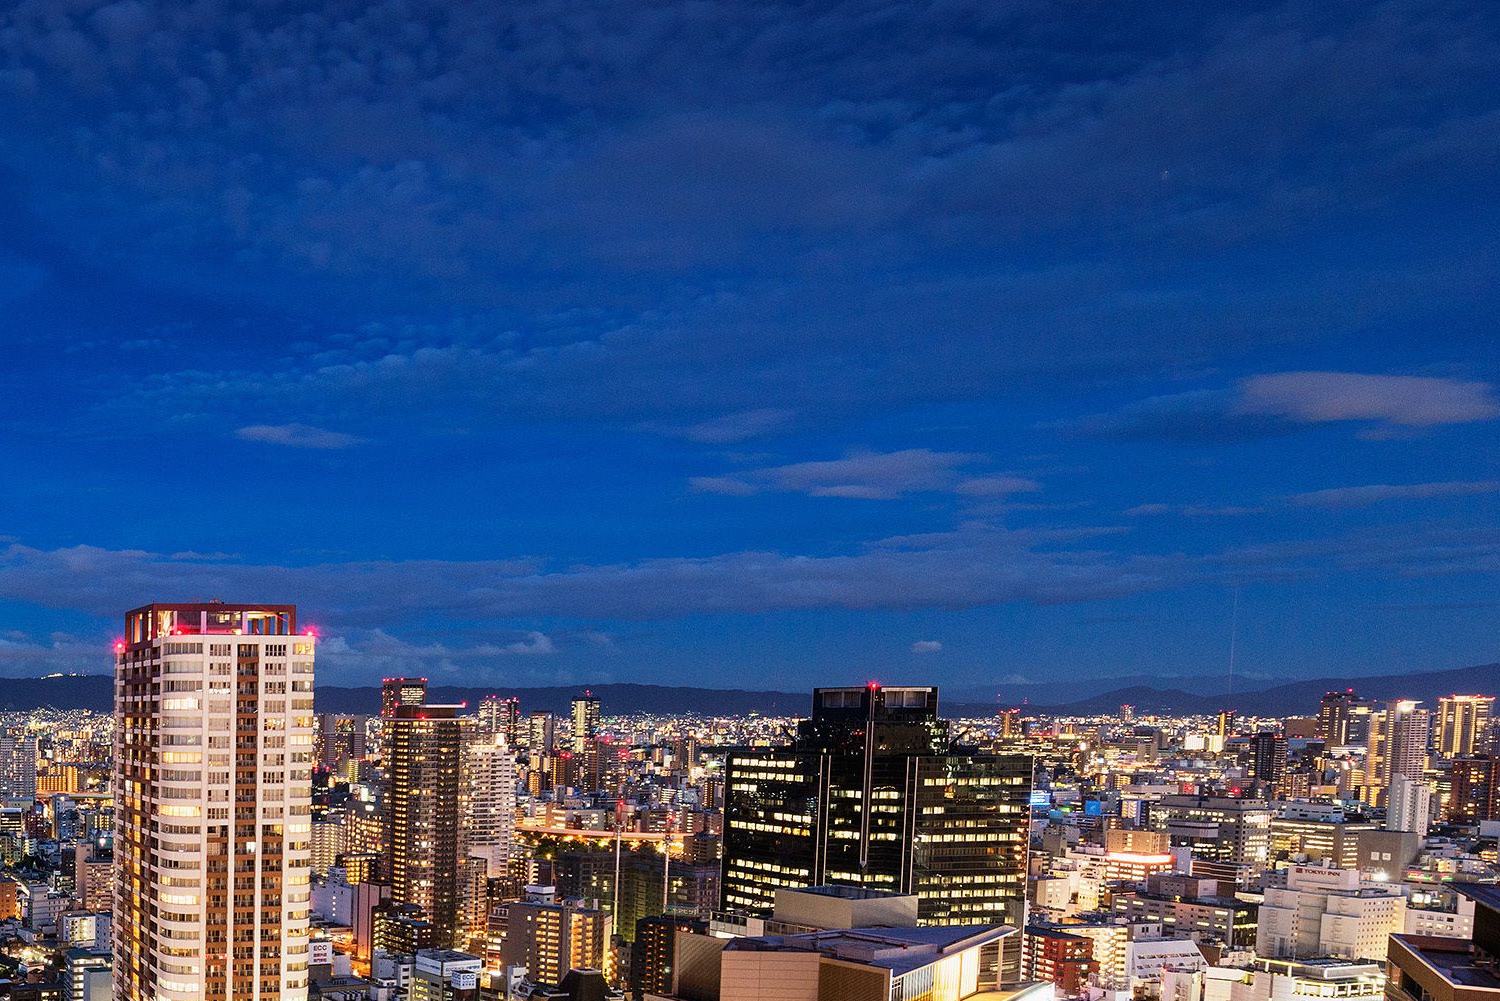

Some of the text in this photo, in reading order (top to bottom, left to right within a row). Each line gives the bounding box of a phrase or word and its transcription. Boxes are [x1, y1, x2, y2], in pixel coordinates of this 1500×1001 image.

[1304, 868, 1326, 876] TOKYU
[313, 944, 328, 952] ECC
[462, 973, 475, 981] ECC
